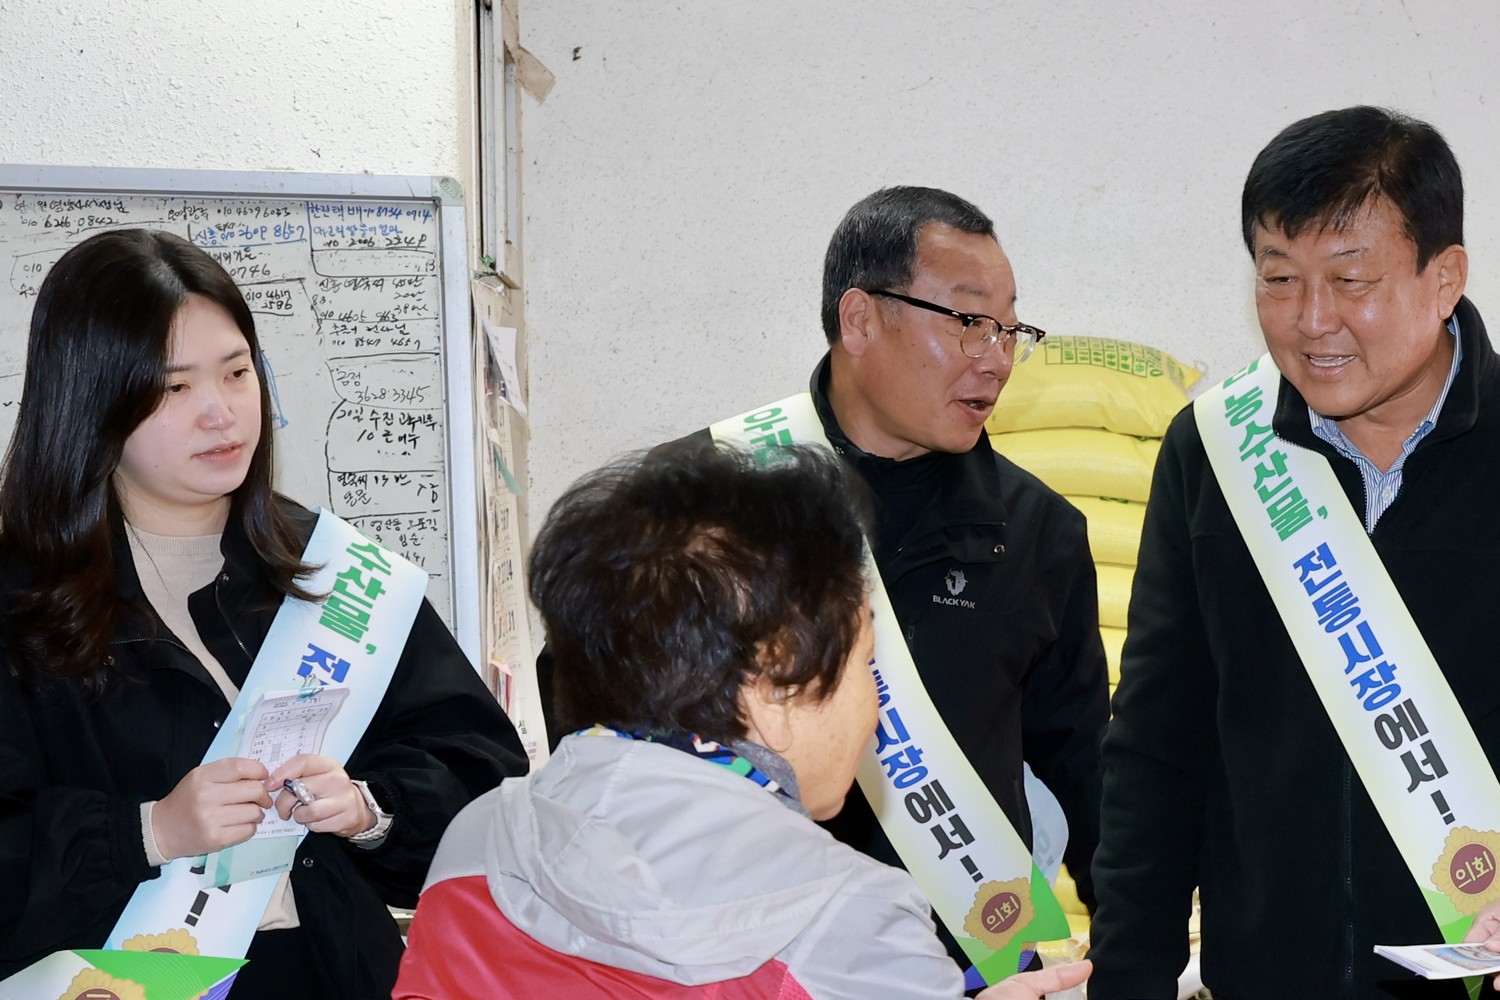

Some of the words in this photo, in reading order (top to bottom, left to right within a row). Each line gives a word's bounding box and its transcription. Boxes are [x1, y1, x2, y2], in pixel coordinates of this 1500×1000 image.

[1224, 385, 1329, 542] 농수산물,
[1292, 541, 1456, 825] 전통시장에서!
[985, 895, 1021, 933] 의회
[1454, 849, 1495, 889] 의회
